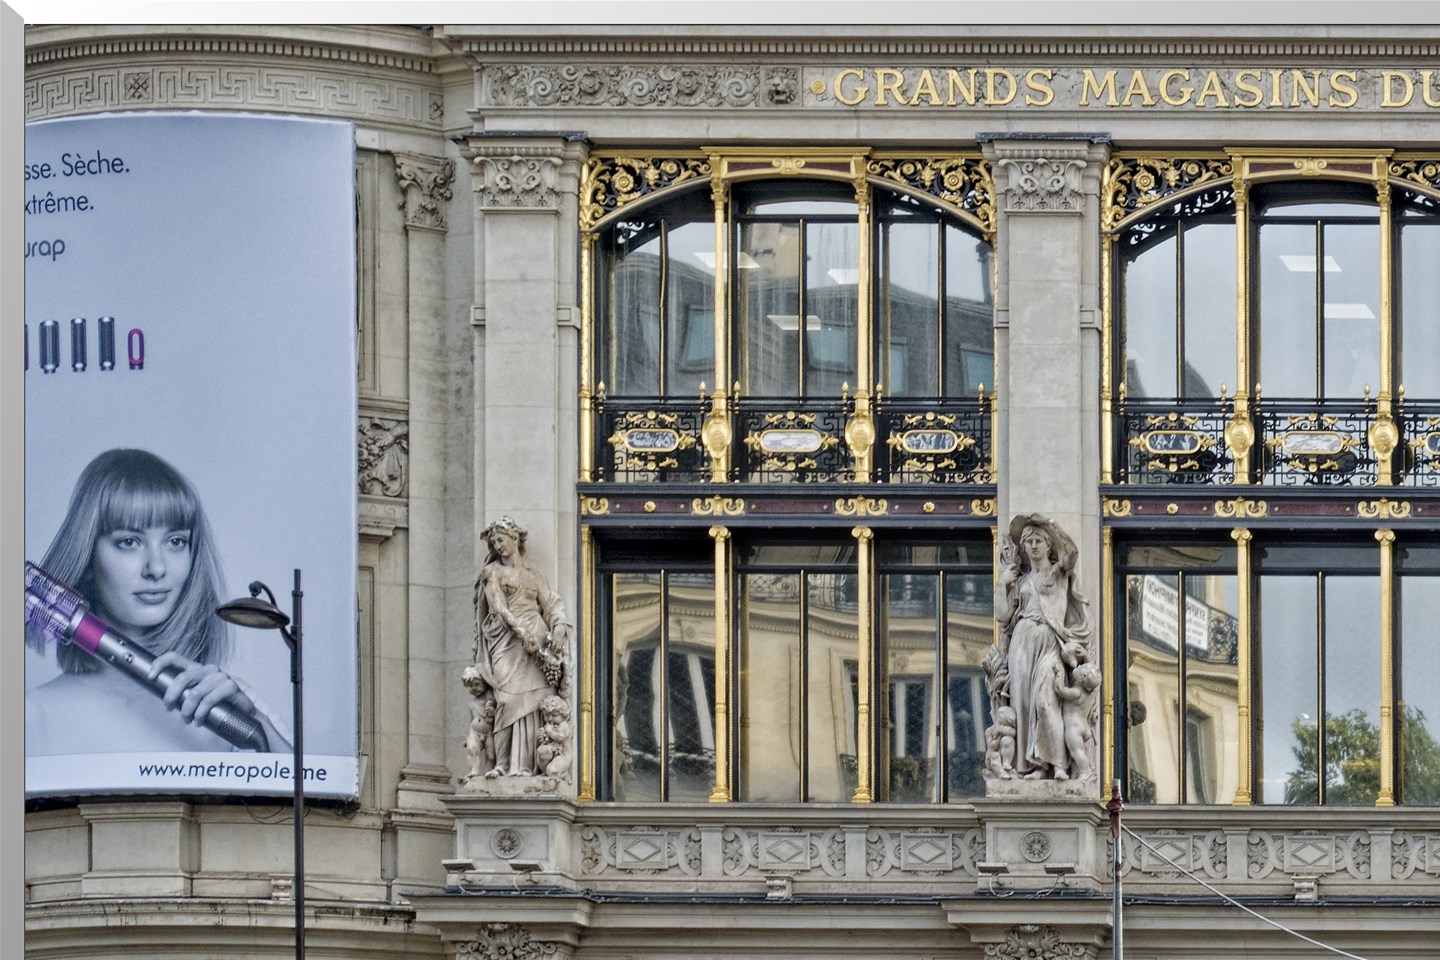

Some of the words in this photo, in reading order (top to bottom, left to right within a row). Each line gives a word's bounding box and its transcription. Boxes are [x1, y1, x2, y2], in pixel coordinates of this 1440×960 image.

[833, 69, 1055, 107] GRANDS
[1080, 69, 1358, 108] MAGASINS
[61, 150, 130, 177] Sèche.
[139, 761, 327, 782] www.metropole.me
